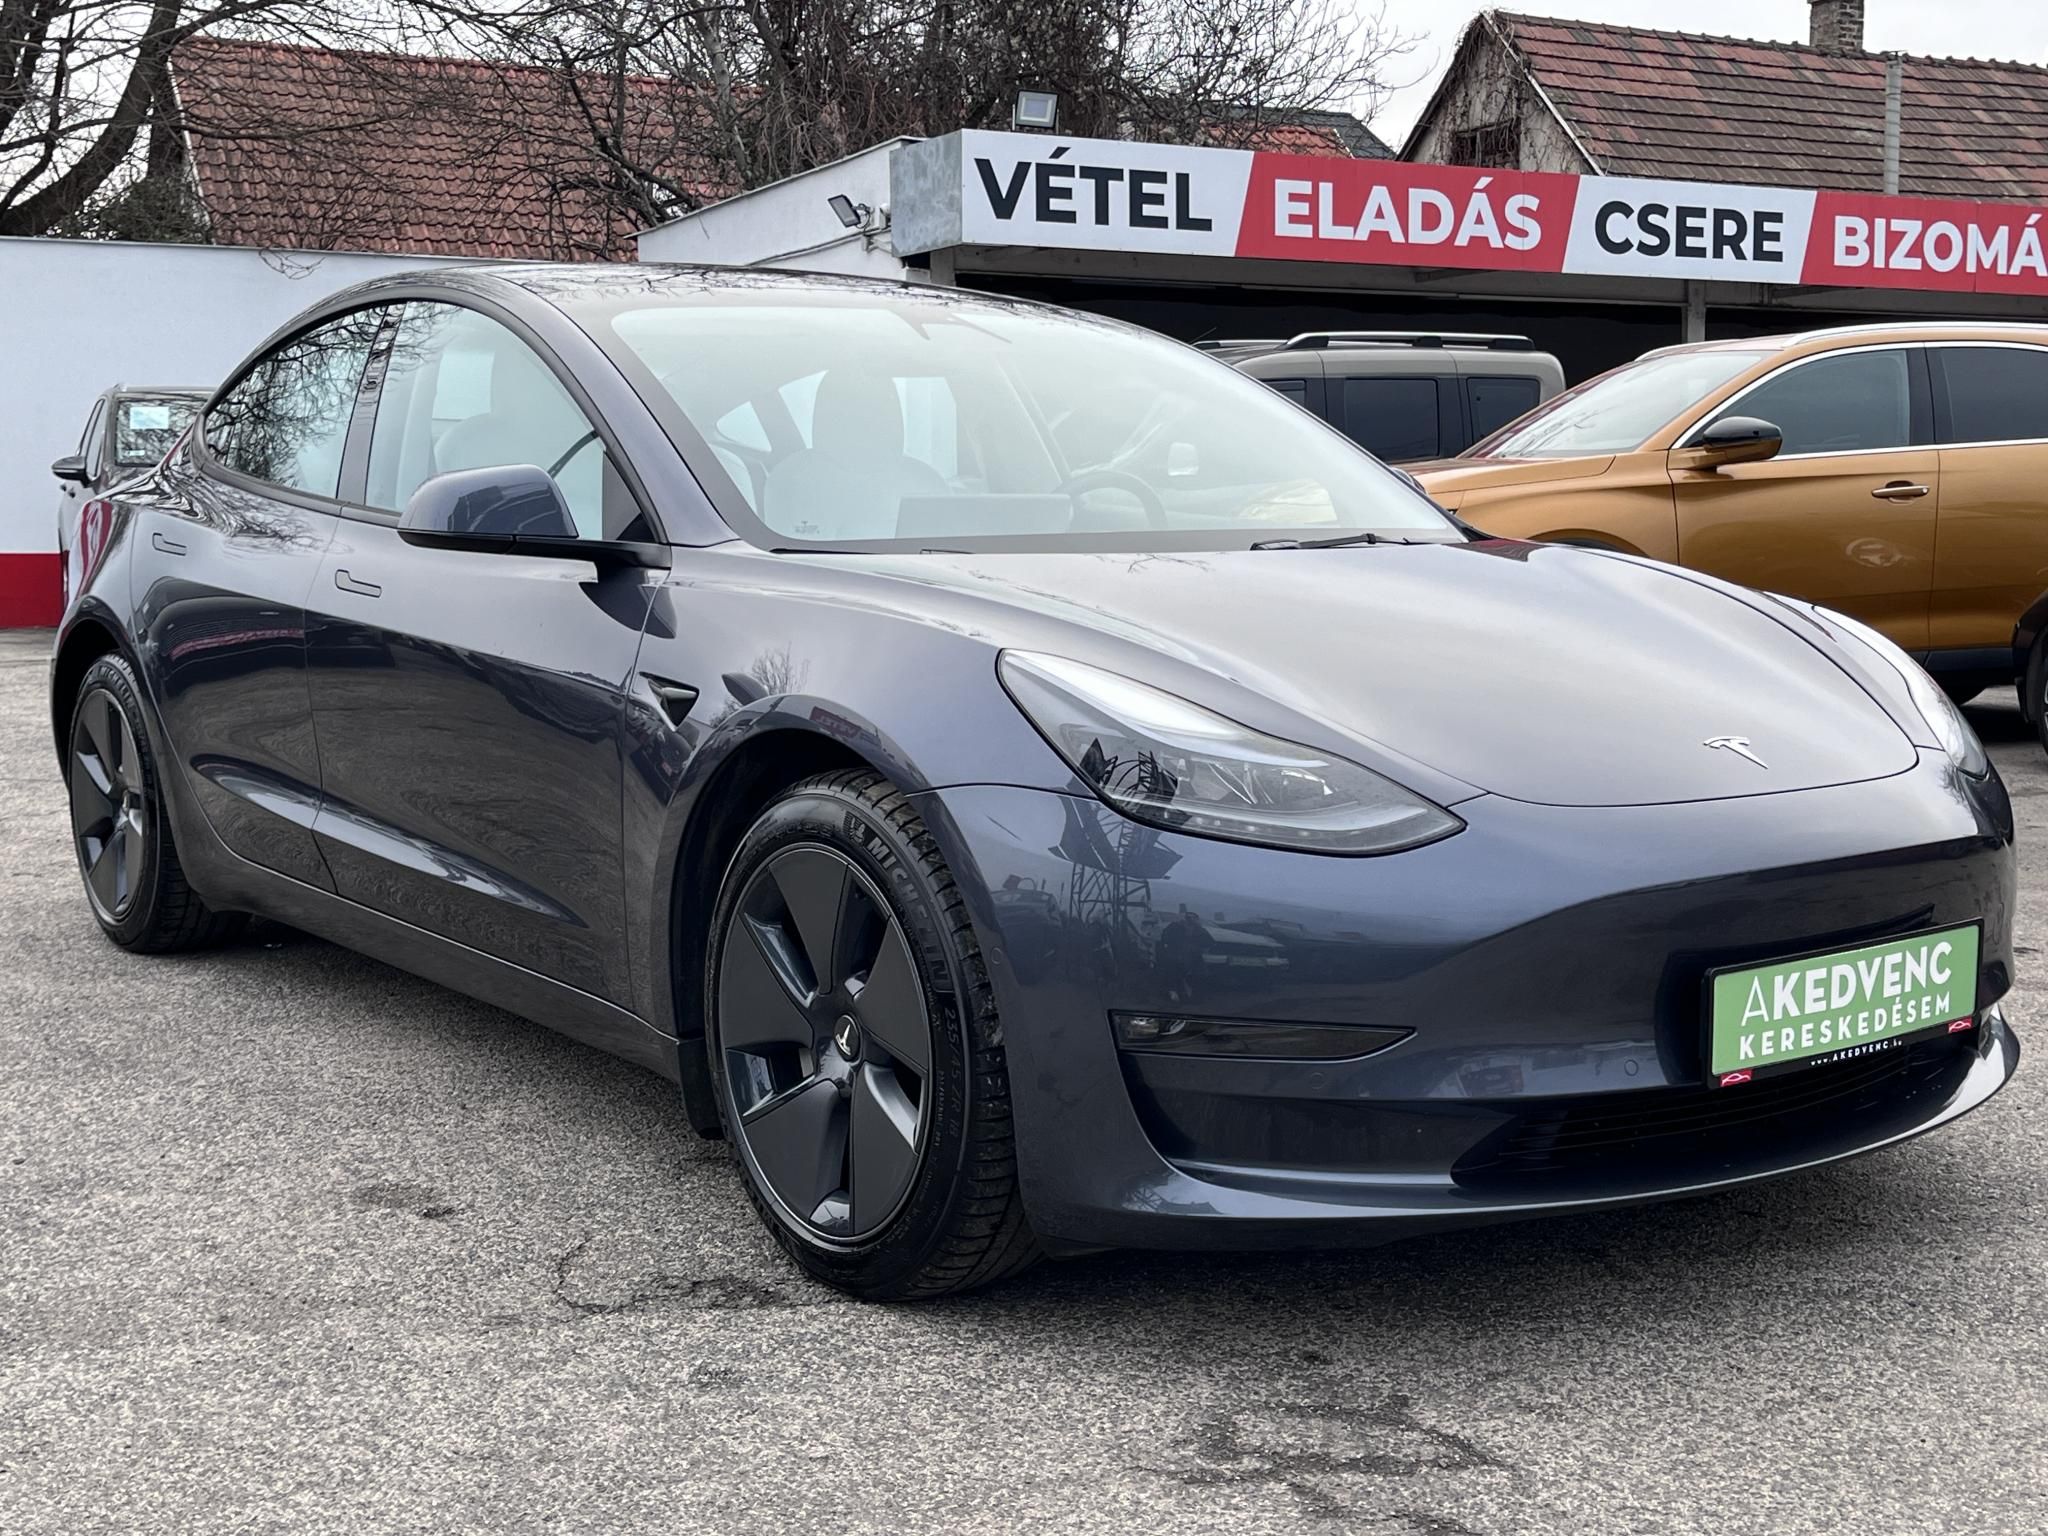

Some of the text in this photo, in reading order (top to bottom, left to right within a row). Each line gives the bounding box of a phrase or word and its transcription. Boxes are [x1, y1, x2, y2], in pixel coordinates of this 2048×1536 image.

[974, 146, 1213, 232] VÉTEL
[1274, 176, 1543, 250] ELADÁS
[1594, 200, 1784, 263] CSERE
[867, 836, 953, 988] MICHELIN
[1739, 991, 1950, 1060] KERESKEDÉSEM
